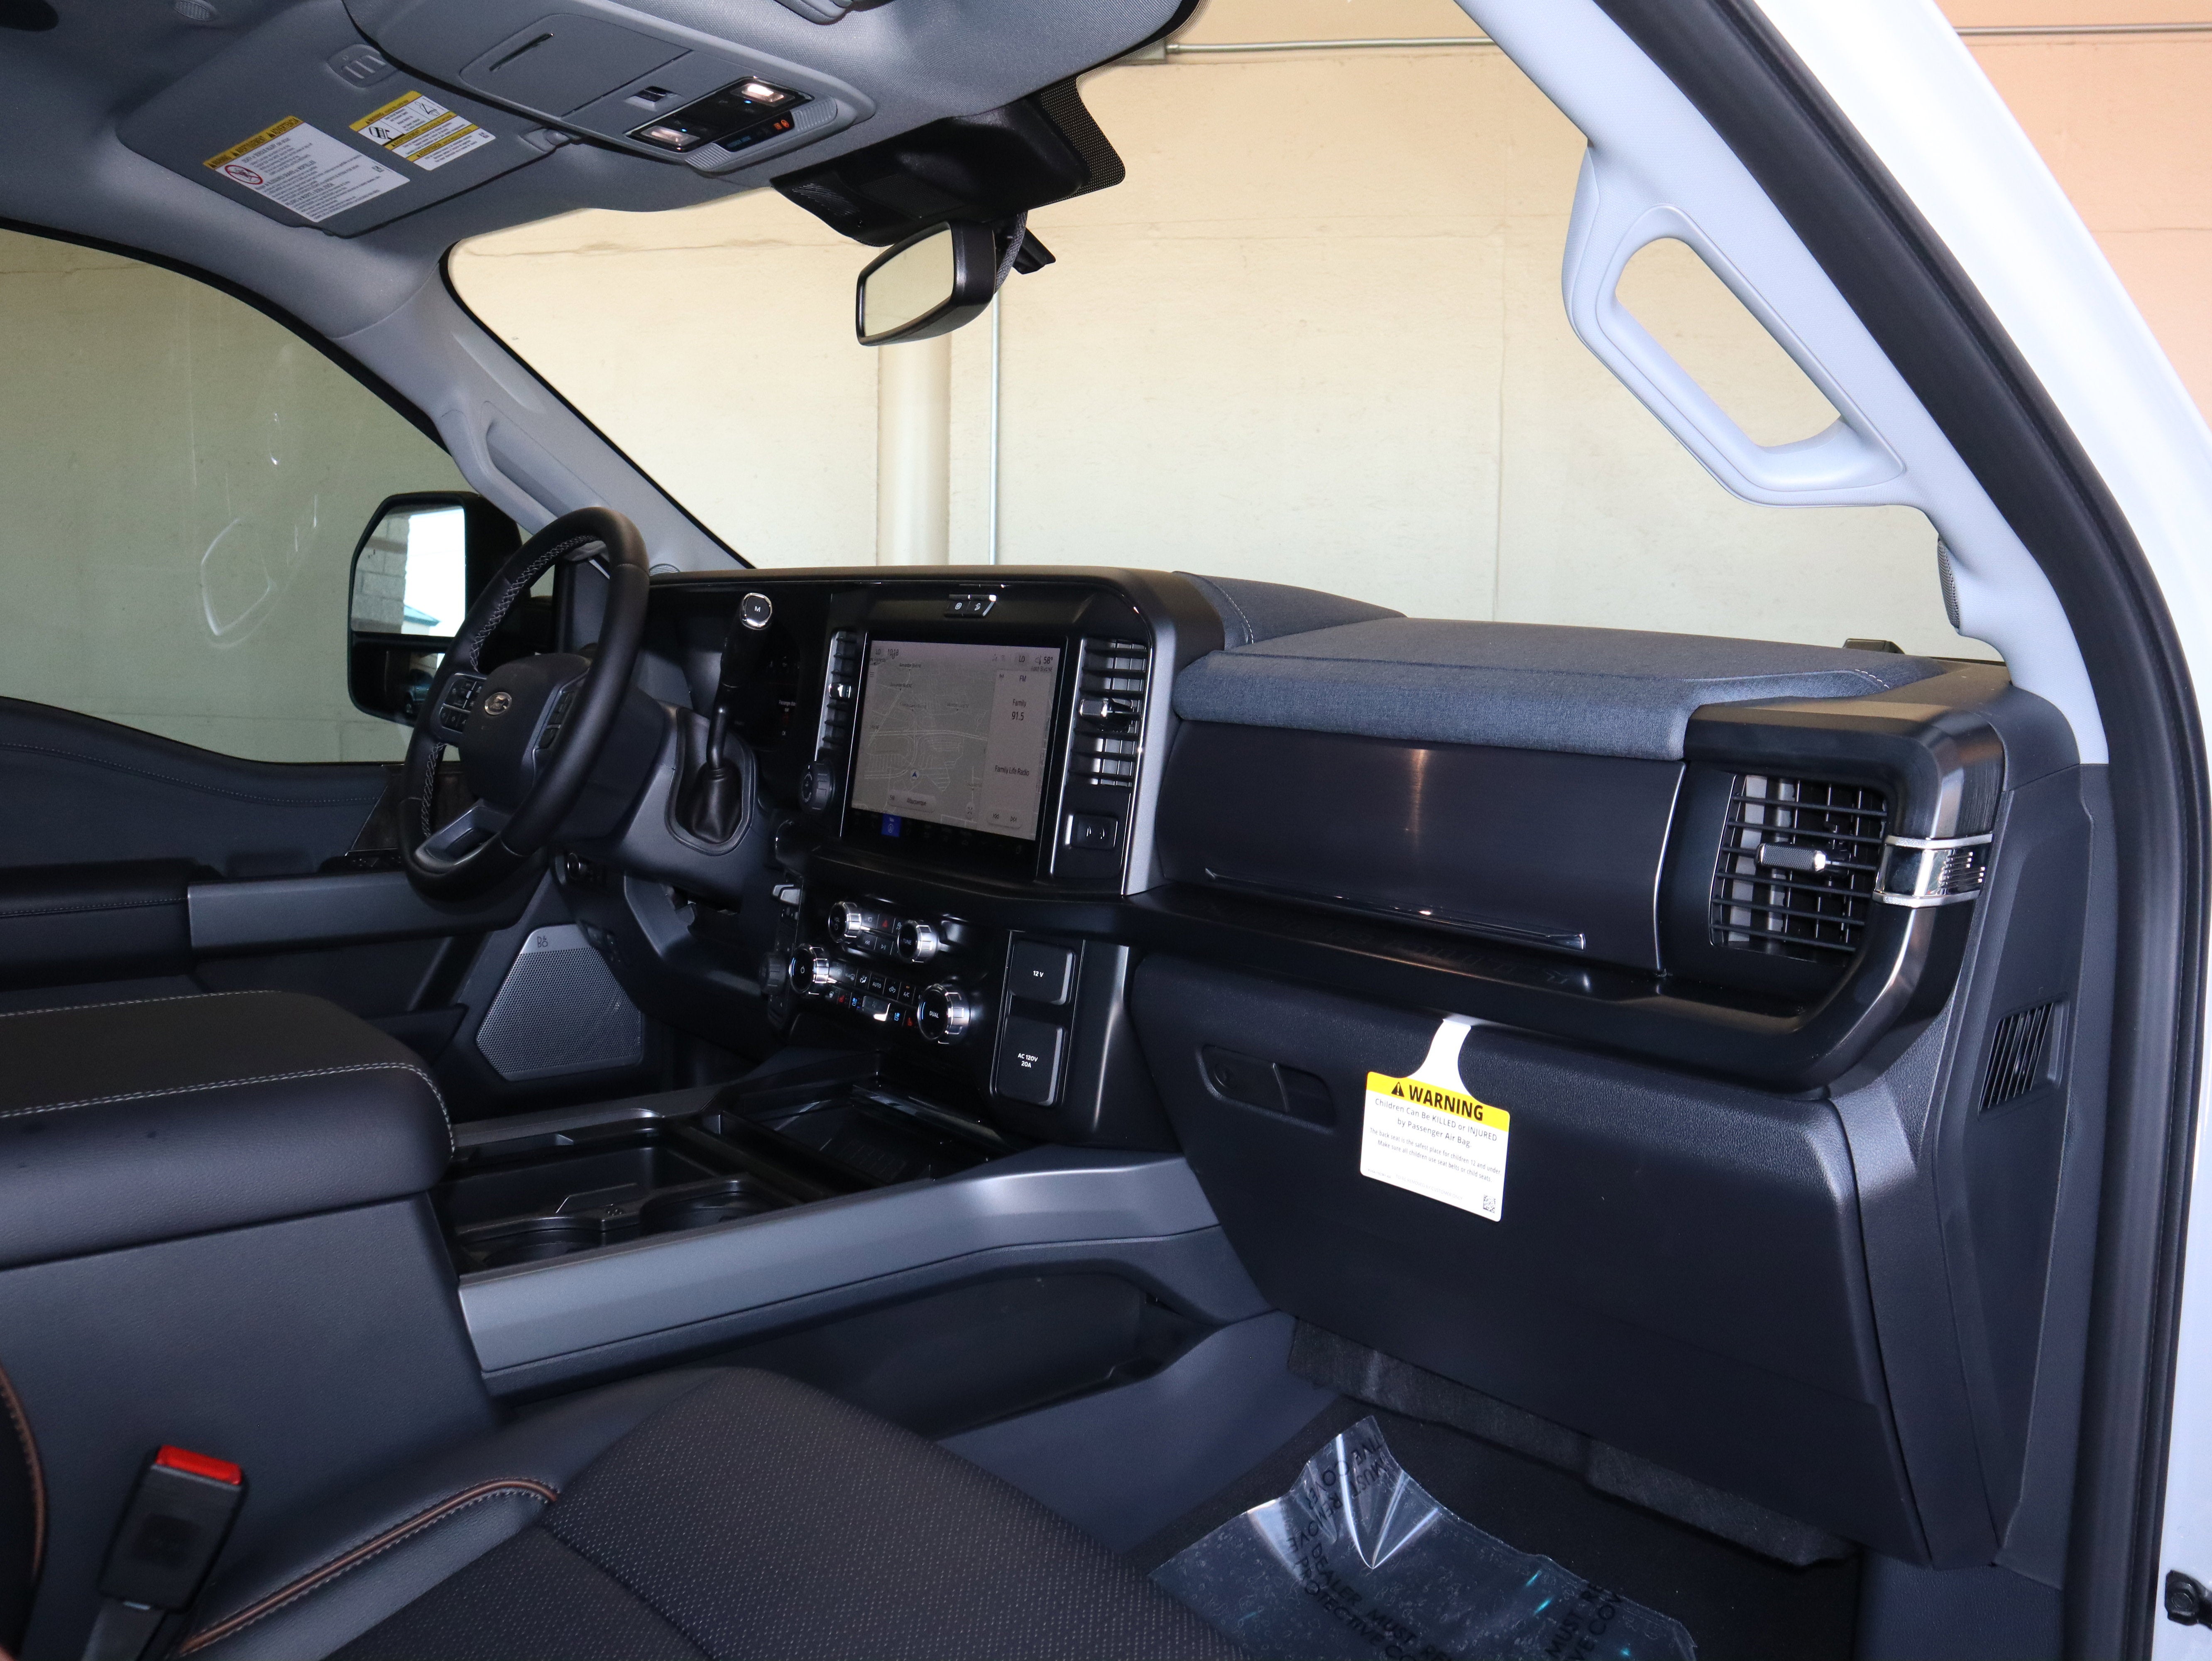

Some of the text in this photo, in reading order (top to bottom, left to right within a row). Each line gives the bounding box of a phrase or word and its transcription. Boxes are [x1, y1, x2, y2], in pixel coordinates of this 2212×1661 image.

[1043, 656, 1053, 664] 58°
[1012, 711, 1024, 721] 91.5
[1013, 699, 1027, 708] Family
[995, 765, 1008, 774] Family
[1017, 768, 1030, 776] Radio
[1375, 1097, 1404, 1113] Children
[1406, 1107, 1419, 1117] Can
[1422, 1112, 1430, 1121] Be
[1432, 1115, 1456, 1128] KILLED
[1468, 1126, 1498, 1143] INJURED
[1409, 1085, 1483, 1121] WARNING
[1397, 1117, 1472, 1149] by Passenger Air Bag.
[1378, 1139, 1390, 1149] Make
[1409, 1149, 1427, 1161] children
[1448, 1162, 1459, 1171] belts
[1467, 1169, 1478, 1178] child
[1479, 1173, 1492, 1182] seats.
[1379, 1130, 1389, 1139] back
[1415, 1141, 1428, 1151] safest
[1429, 1146, 1441, 1156] place
[1450, 1153, 1469, 1164] children
[1486, 1165, 1502, 1176] under.
[1295, 1556, 1385, 1646] PROTECTIVE
[1312, 1542, 1363, 1606] DEALER
[1368, 1608, 1417, 1644] MUST
[1544, 1609, 1581, 1659] MUST
